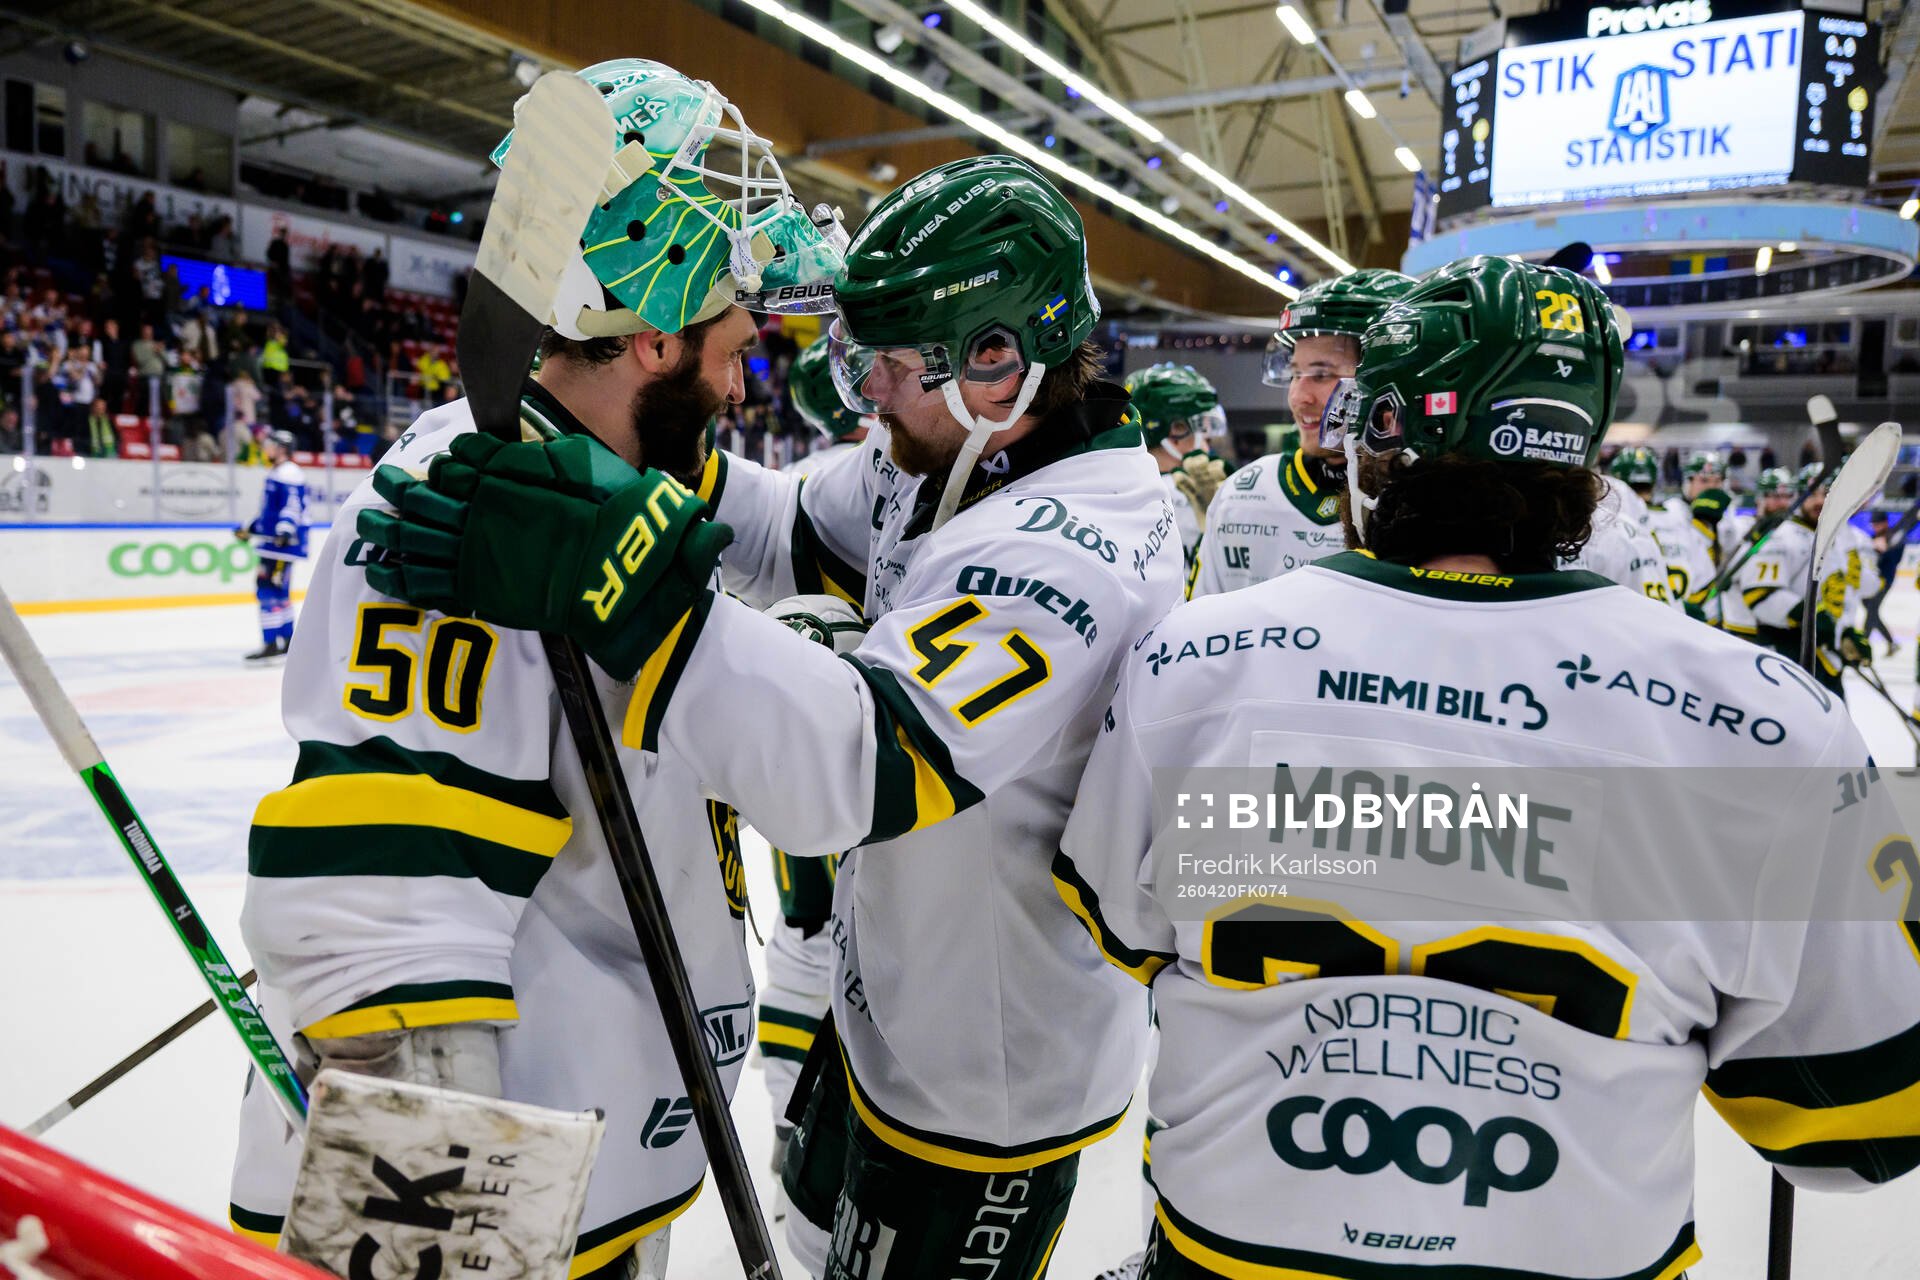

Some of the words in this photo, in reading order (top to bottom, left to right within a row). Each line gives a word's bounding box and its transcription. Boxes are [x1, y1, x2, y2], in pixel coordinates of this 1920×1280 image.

[1587, 0, 1712, 37] Prevas
[1503, 52, 1595, 98] STIK
[1671, 28, 1797, 78] STATI
[614, 95, 668, 135] MEÅ
[1565, 125, 1731, 168] STATISTIK
[946, 177, 997, 216] BUSS
[779, 284, 833, 300] BAUE
[1535, 289, 1585, 334] 28
[1524, 427, 1585, 451] BASTU
[582, 470, 695, 623] UER
[1015, 496, 1119, 564] Diös
[1145, 497, 1175, 568] ADER
[108, 542, 260, 582] coop
[1757, 562, 1779, 580] 71
[343, 602, 499, 734] 50
[904, 593, 1053, 730] 47
[1176, 626, 1321, 663] ADERO
[1317, 669, 1429, 711] NIEMI
[1606, 670, 1786, 745] ADERO
[1268, 762, 1572, 892] MAIONE
[204, 960, 292, 1076] FLYLITE
[1304, 993, 1520, 1046] NORDIC
[1266, 1038, 1562, 1100] WELLNESS
[1266, 1095, 1559, 1208] coop
[462, 1153, 518, 1272] ETER
